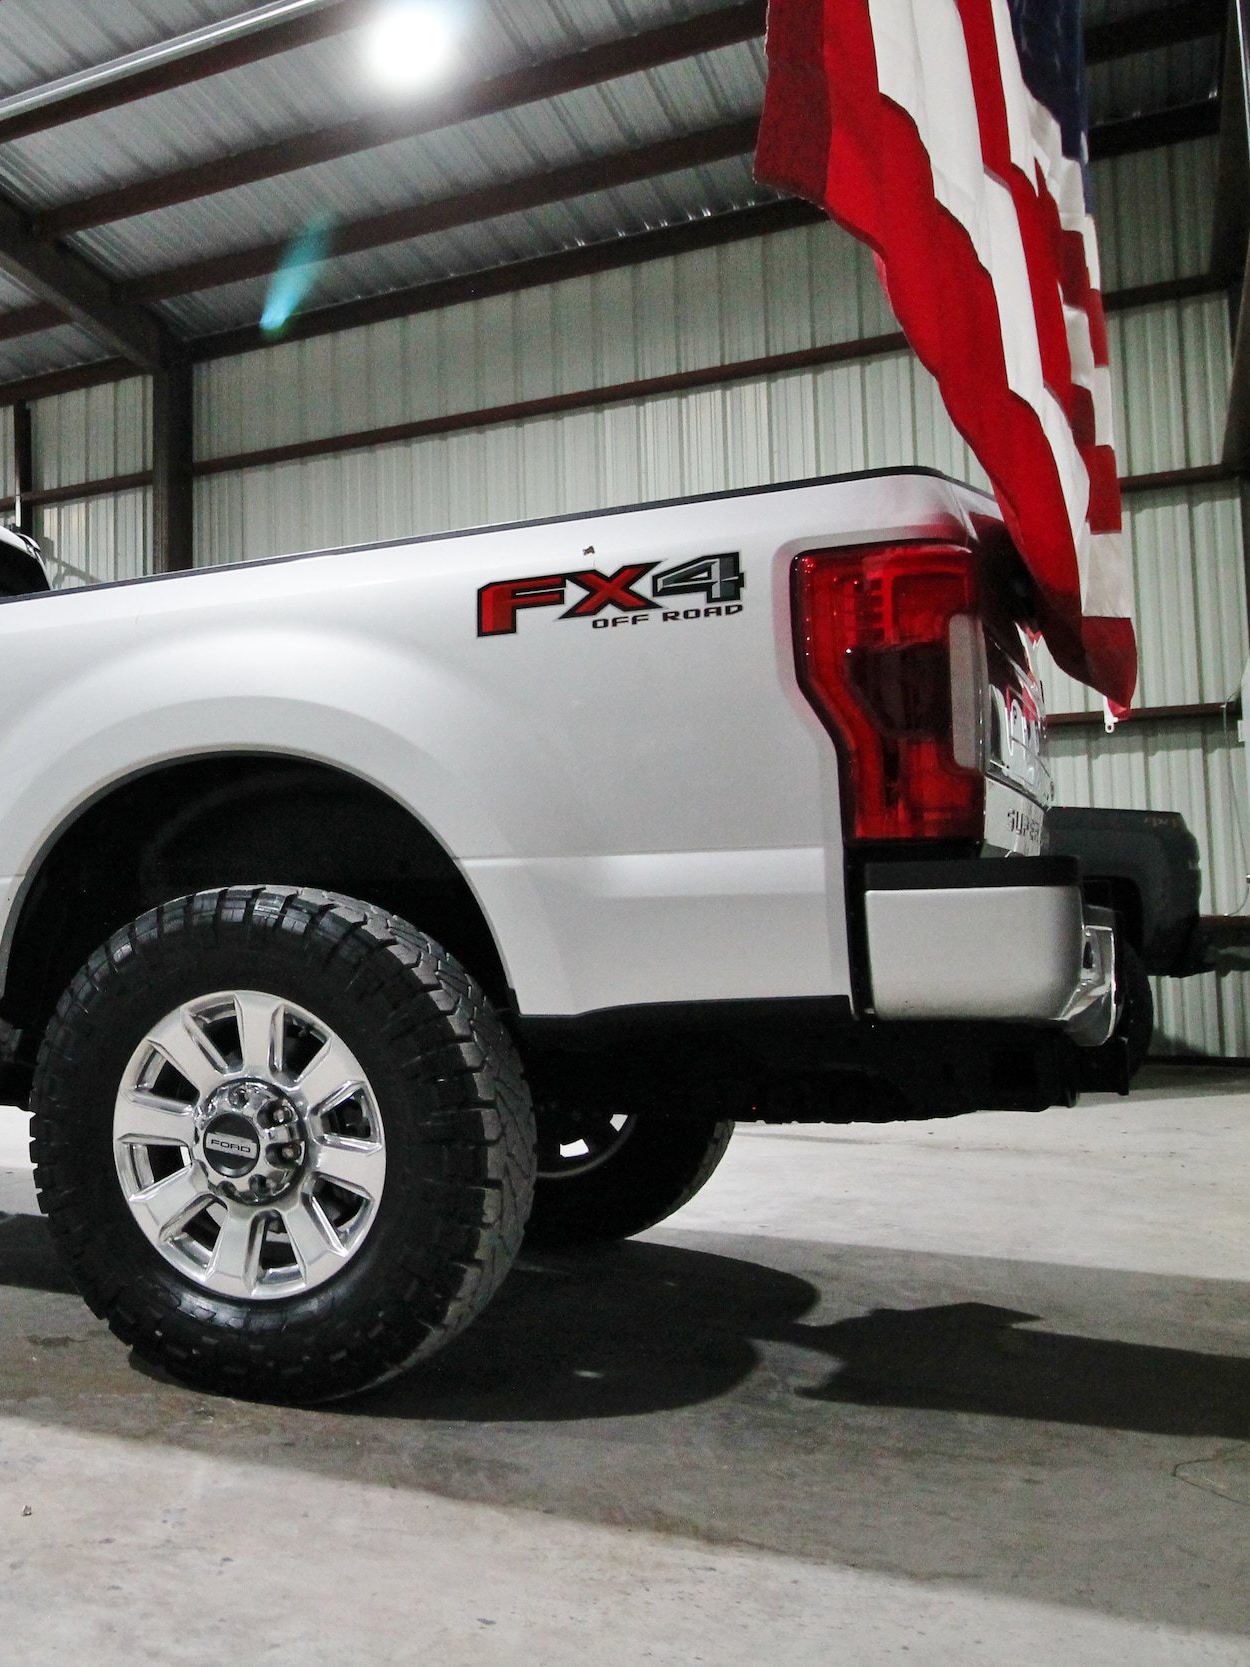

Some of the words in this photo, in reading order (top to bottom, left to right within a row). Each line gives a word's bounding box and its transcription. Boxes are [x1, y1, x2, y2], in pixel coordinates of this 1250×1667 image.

[476, 550, 745, 638] FX4
[591, 613, 650, 629] OFF
[662, 603, 744, 622] ROAD
[210, 1138, 251, 1153] FORD
